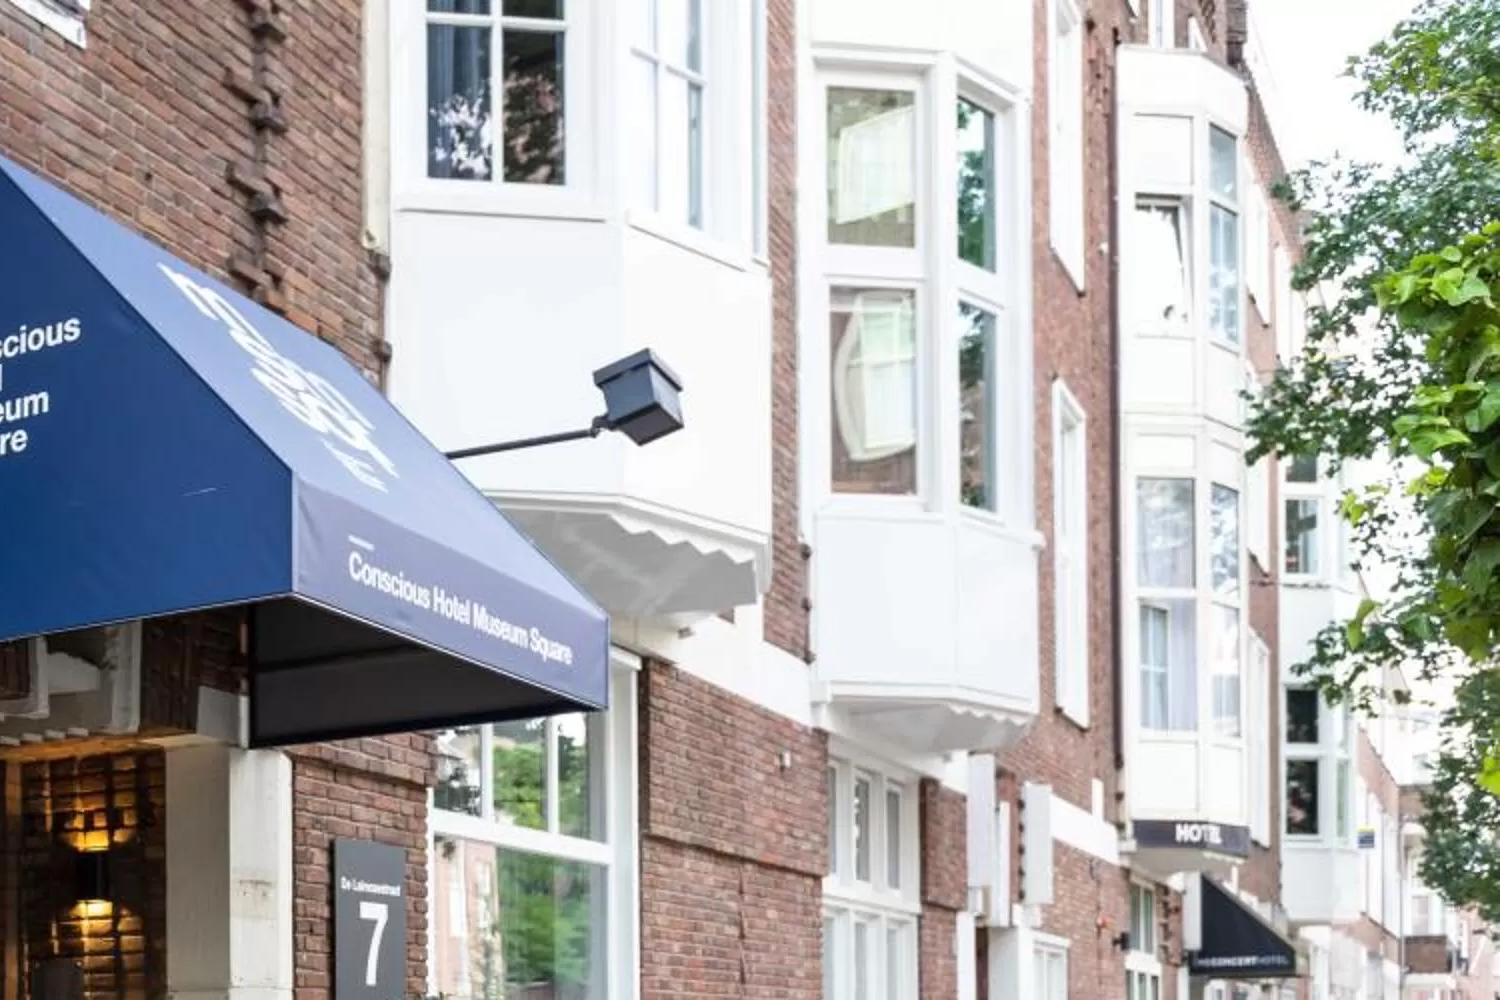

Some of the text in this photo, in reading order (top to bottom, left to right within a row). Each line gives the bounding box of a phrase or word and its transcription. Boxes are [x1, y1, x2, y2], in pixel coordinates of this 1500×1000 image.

[348, 551, 573, 666] Conscious Hotel Museum Square
[1175, 823, 1222, 844] HOTEL
[359, 901, 389, 987] 7
